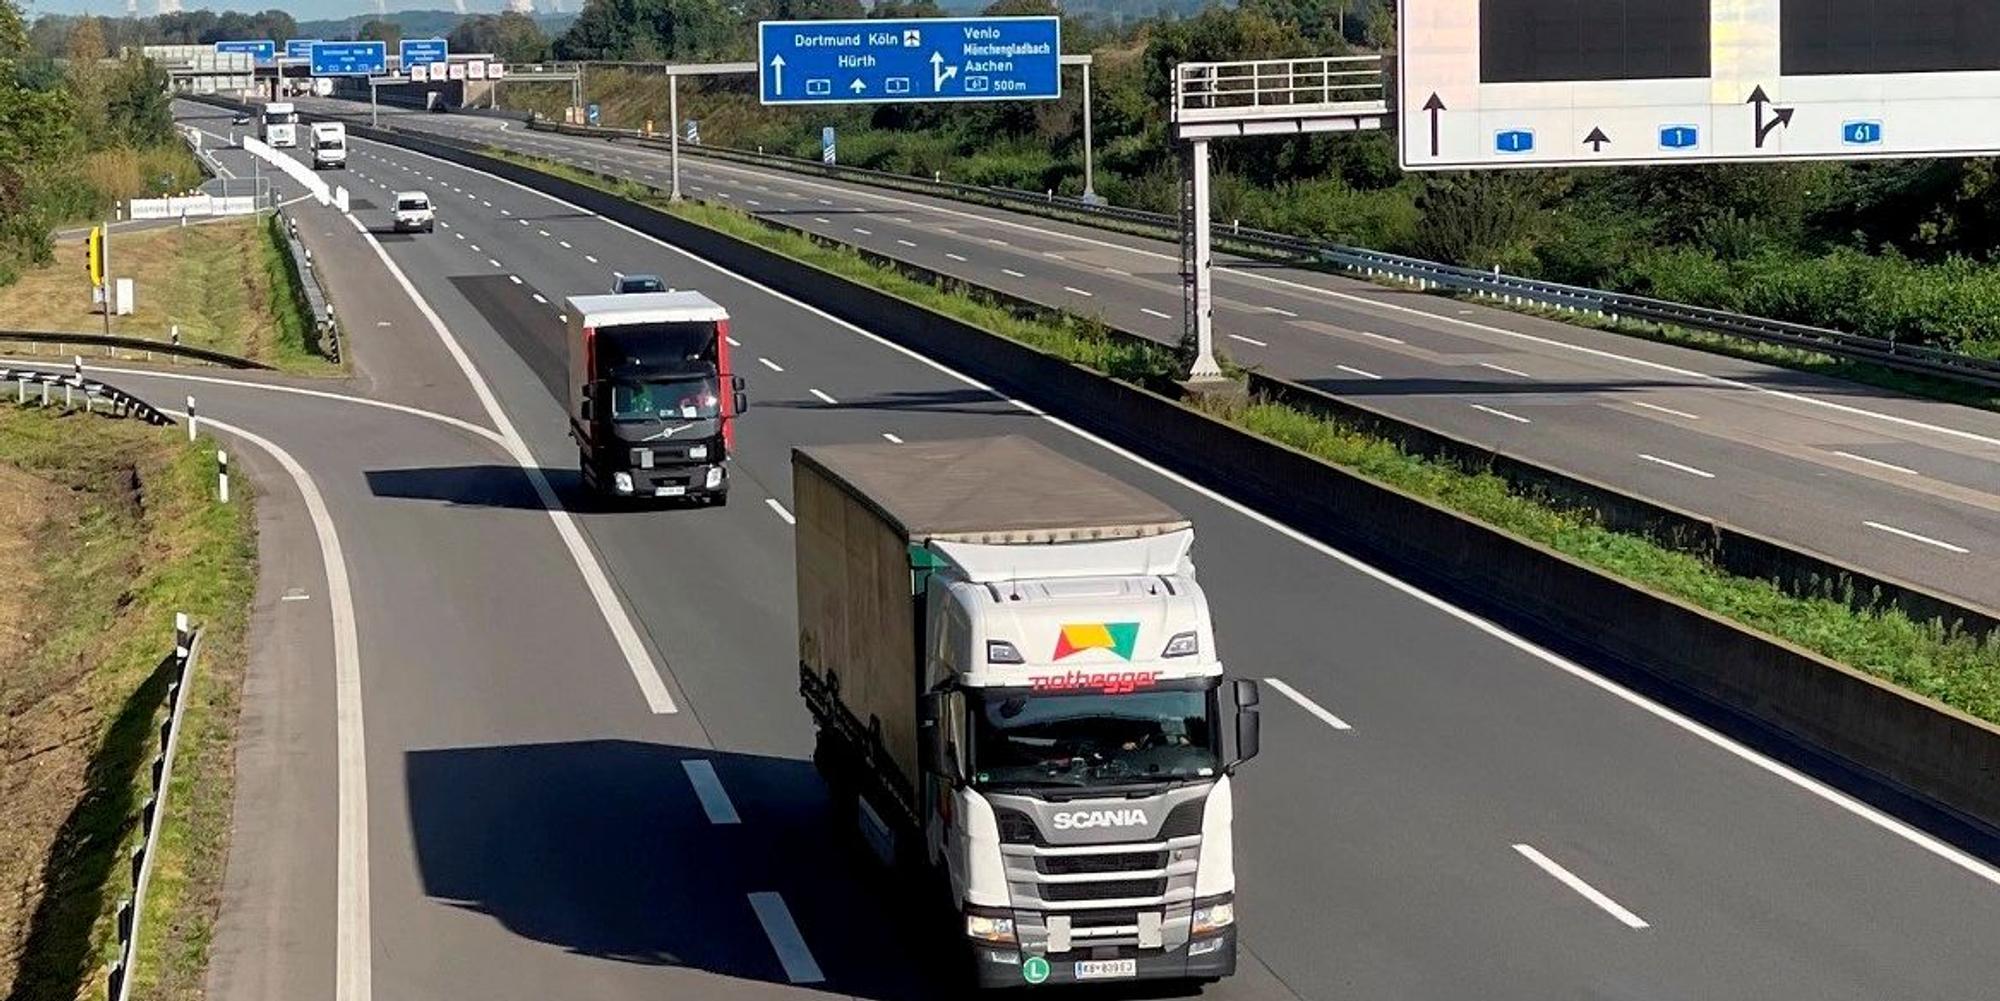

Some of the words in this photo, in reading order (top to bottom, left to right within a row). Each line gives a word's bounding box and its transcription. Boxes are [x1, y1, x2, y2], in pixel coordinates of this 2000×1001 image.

[795, 34, 861, 47] Dortmund
[868, 32, 898, 46] Köln
[963, 27, 1001, 39] Venlo
[963, 42, 1051, 57] Mönchengladbach
[838, 54, 876, 68] Hürth
[964, 60, 1013, 72] Aachen
[993, 80, 1027, 91] 500m
[1854, 125, 1870, 141] 61
[1028, 670, 1164, 694] nothegger
[1053, 808, 1148, 830] SCANIA
[1030, 961, 1043, 979] L
